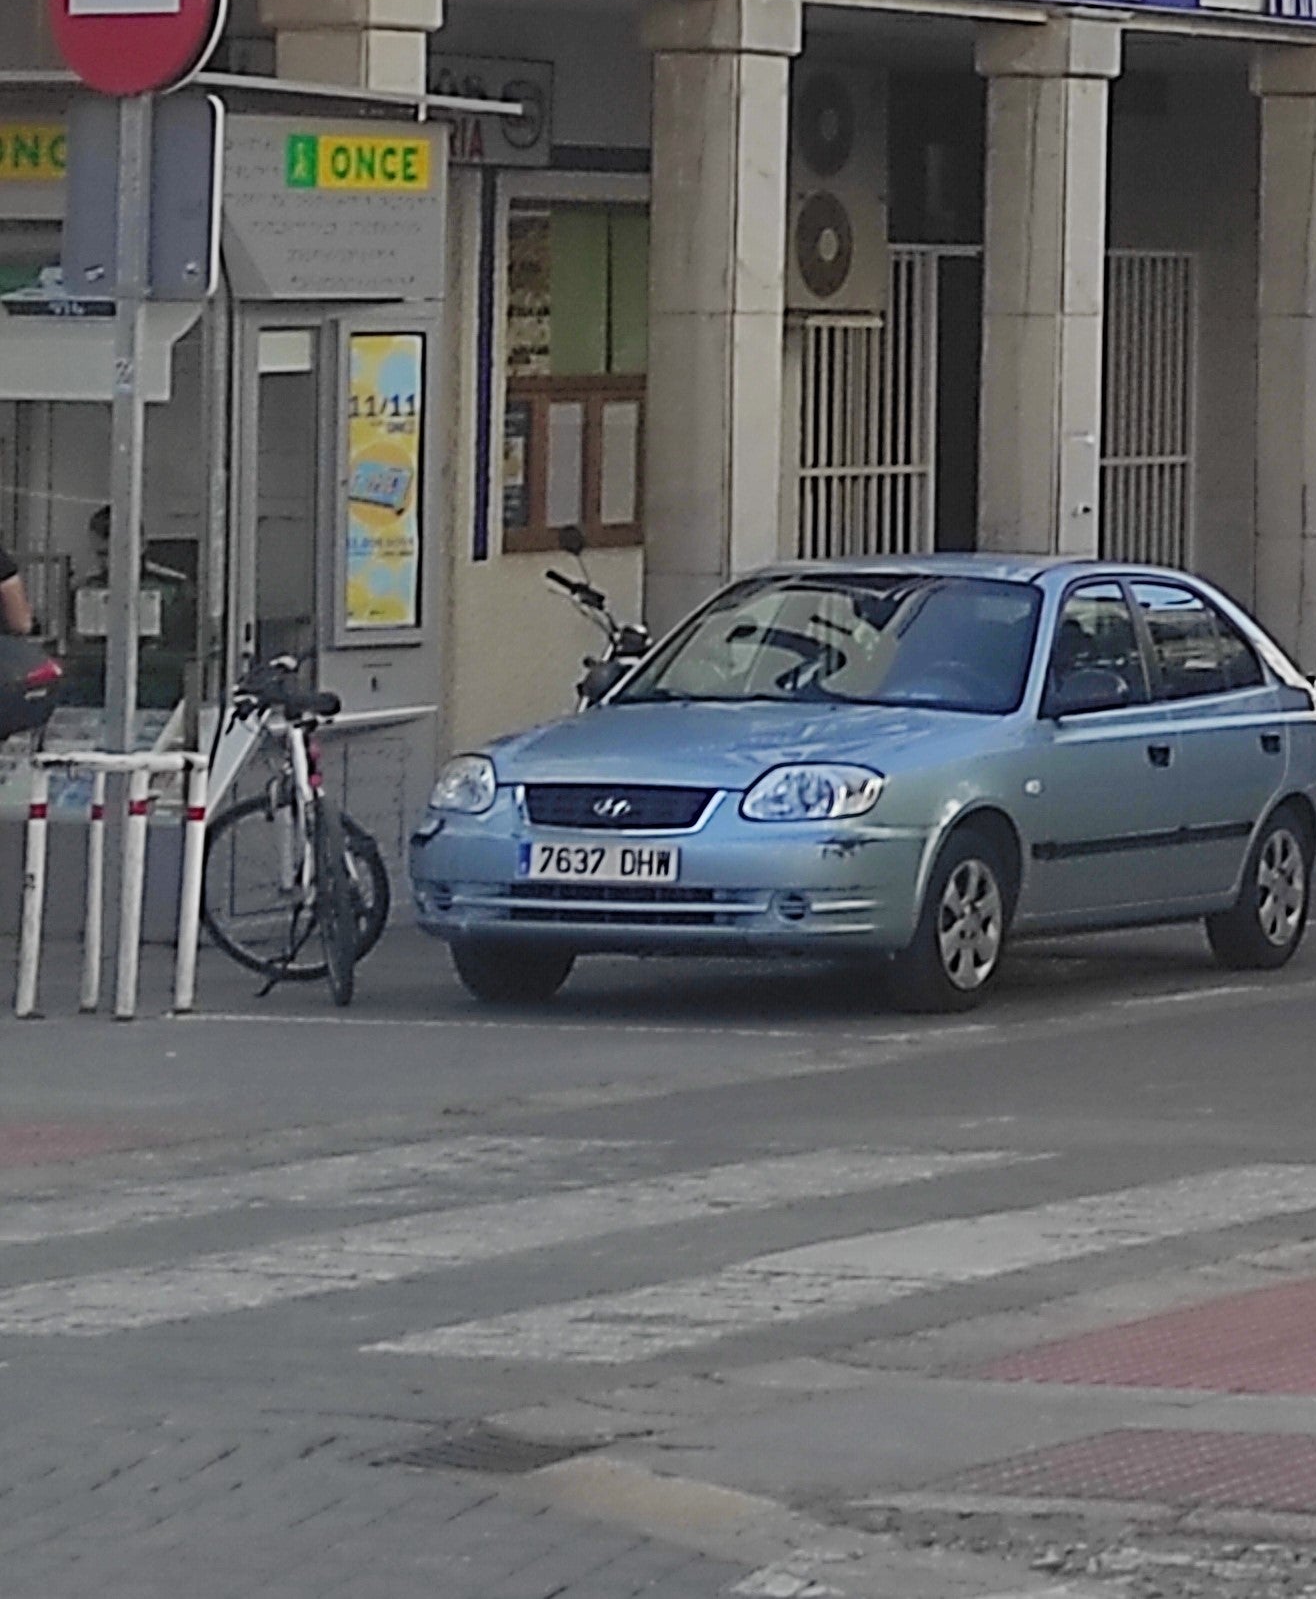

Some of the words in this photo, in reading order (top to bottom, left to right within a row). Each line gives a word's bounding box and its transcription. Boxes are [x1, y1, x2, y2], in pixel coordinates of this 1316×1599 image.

[330, 146, 419, 182] ONCE
[348, 393, 416, 418] 11/11
[538, 846, 606, 875] 7637
[620, 848, 671, 878] DHW
